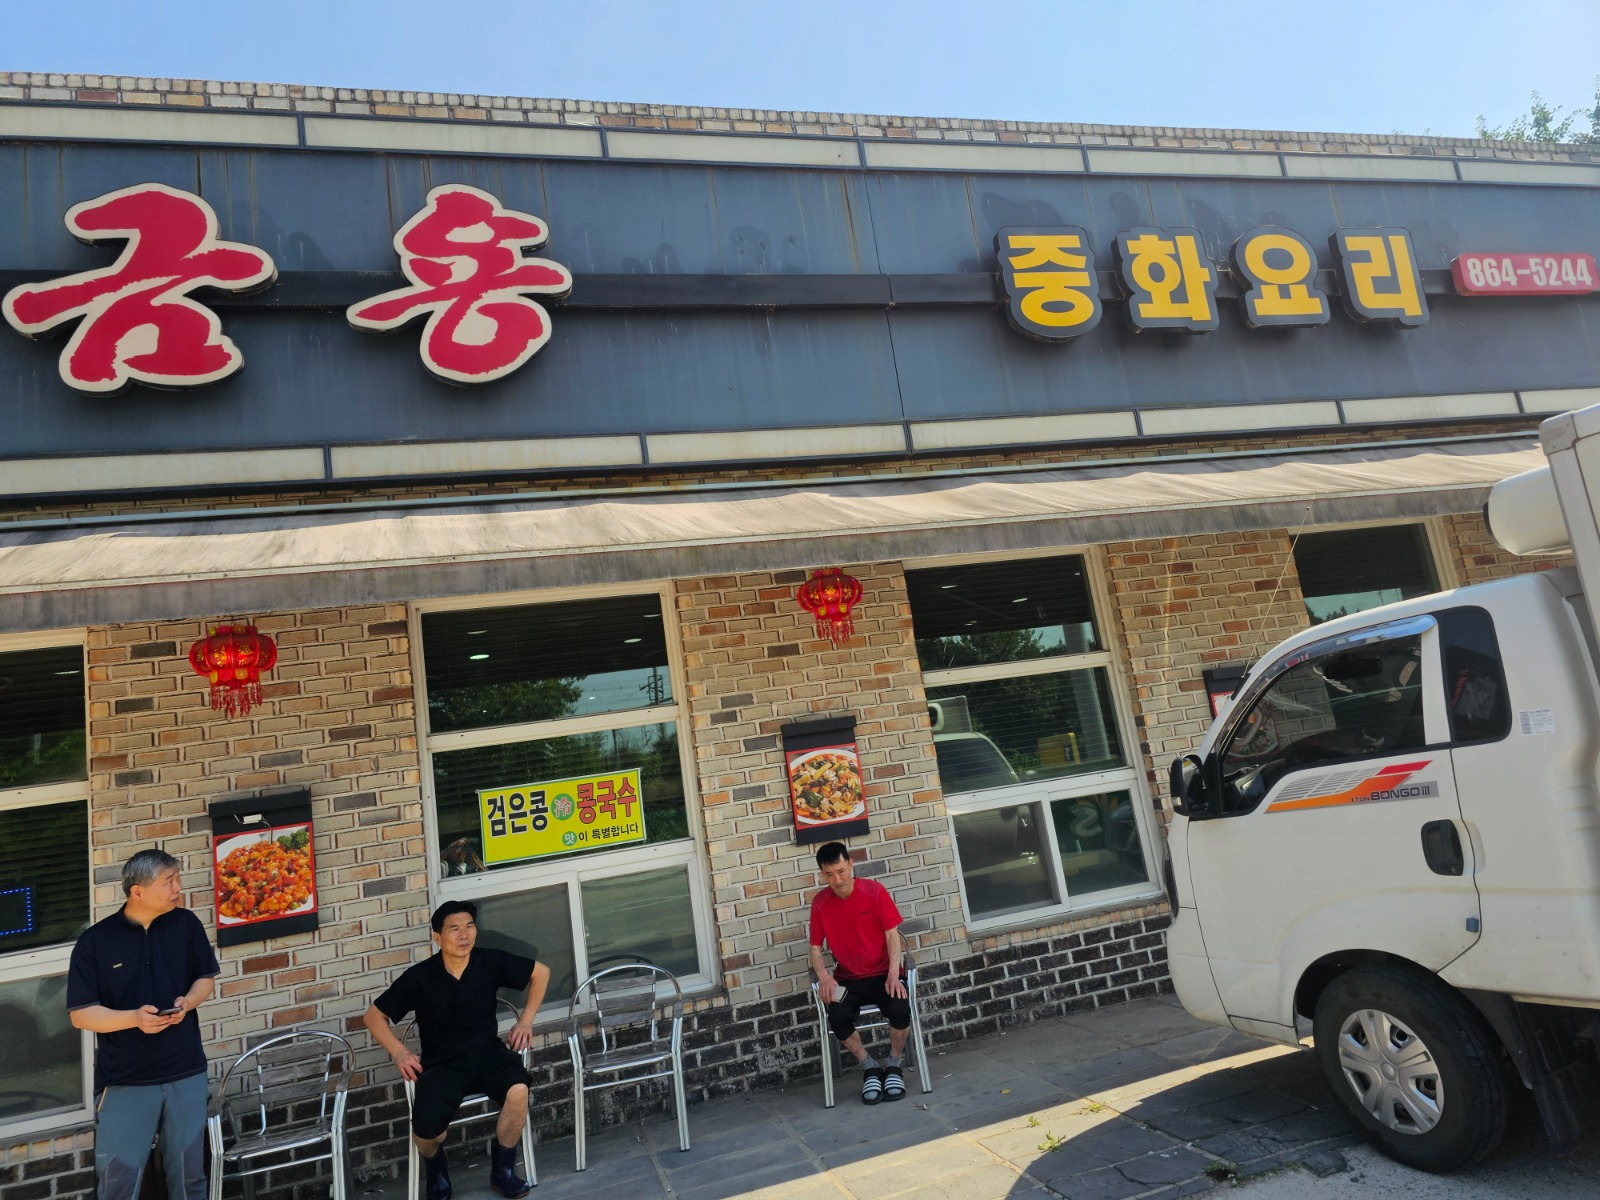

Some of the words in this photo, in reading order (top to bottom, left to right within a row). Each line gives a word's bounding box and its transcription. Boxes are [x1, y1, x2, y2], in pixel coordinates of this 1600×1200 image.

[1006, 234, 1422, 328] 중화요리
[1465, 256, 1593, 288] 864-5244
[486, 790, 549, 838] 검은콩
[554, 796, 574, 818] 冷
[576, 776, 638, 825] 콩국수
[1370, 786, 1420, 801] BONGO
[564, 830, 588, 845] 맛이
[591, 822, 639, 840] 특별합니다
